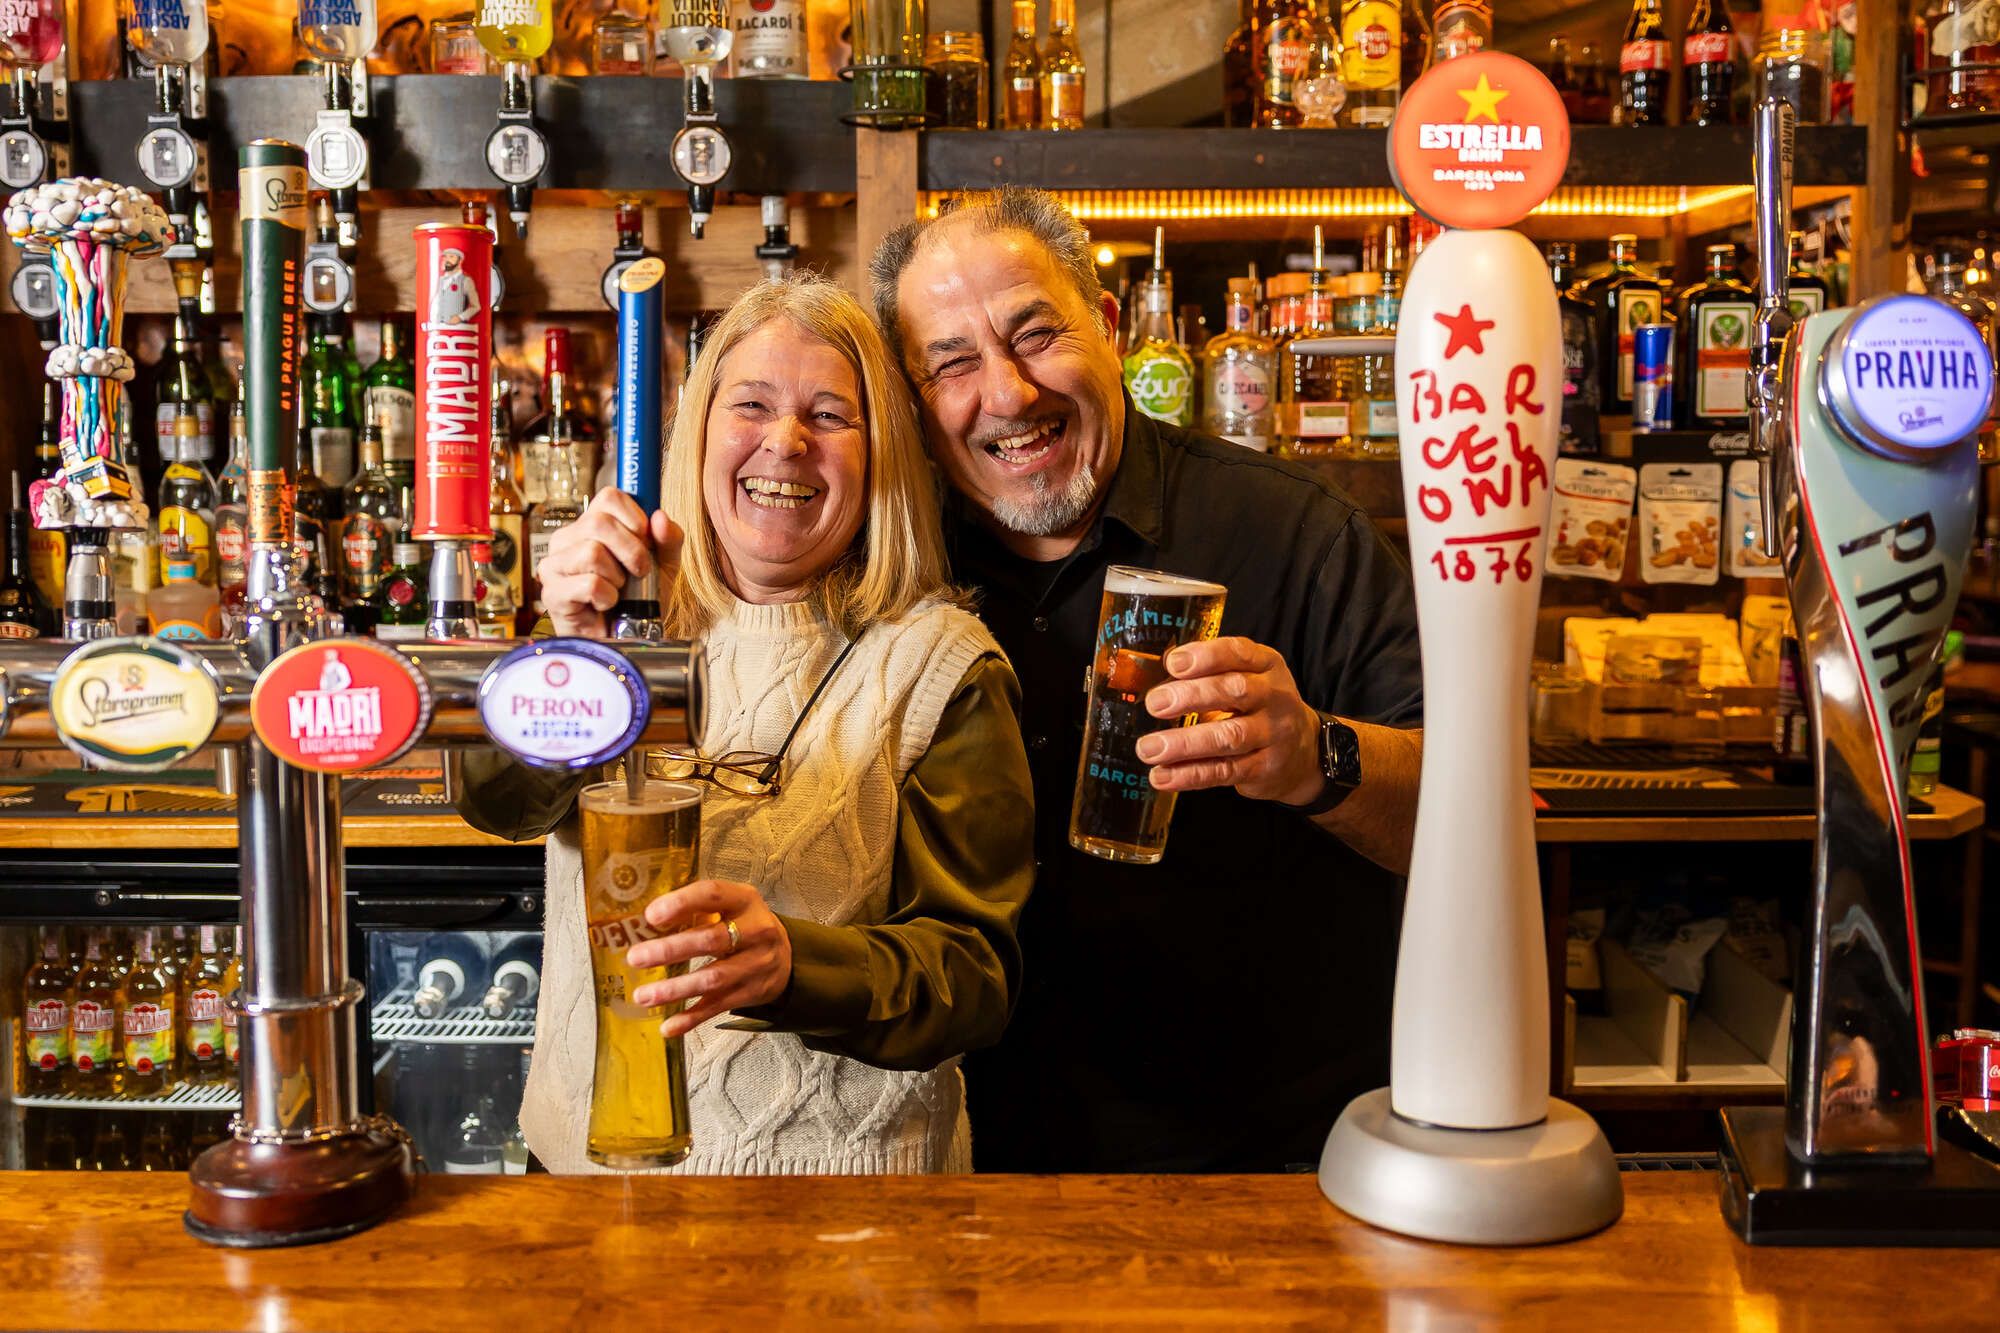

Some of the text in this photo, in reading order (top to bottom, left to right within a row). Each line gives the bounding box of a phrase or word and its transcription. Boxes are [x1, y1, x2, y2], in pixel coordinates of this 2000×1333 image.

[1420, 124, 1543, 151] ESTRELLA
[1781, 111, 1794, 163] PRAVHA
[1433, 169, 1525, 182] BARCELONA
[283, 259, 296, 305] BEER
[281, 313, 295, 385] PRAGUE
[627, 318, 640, 381] AZZURRO
[1855, 350, 1980, 390] PRAVHA
[622, 439, 640, 497] ERONI
[1430, 541, 1534, 585] 1876
[511, 695, 603, 718] PERONI
[1089, 763, 1149, 789] BARCE
